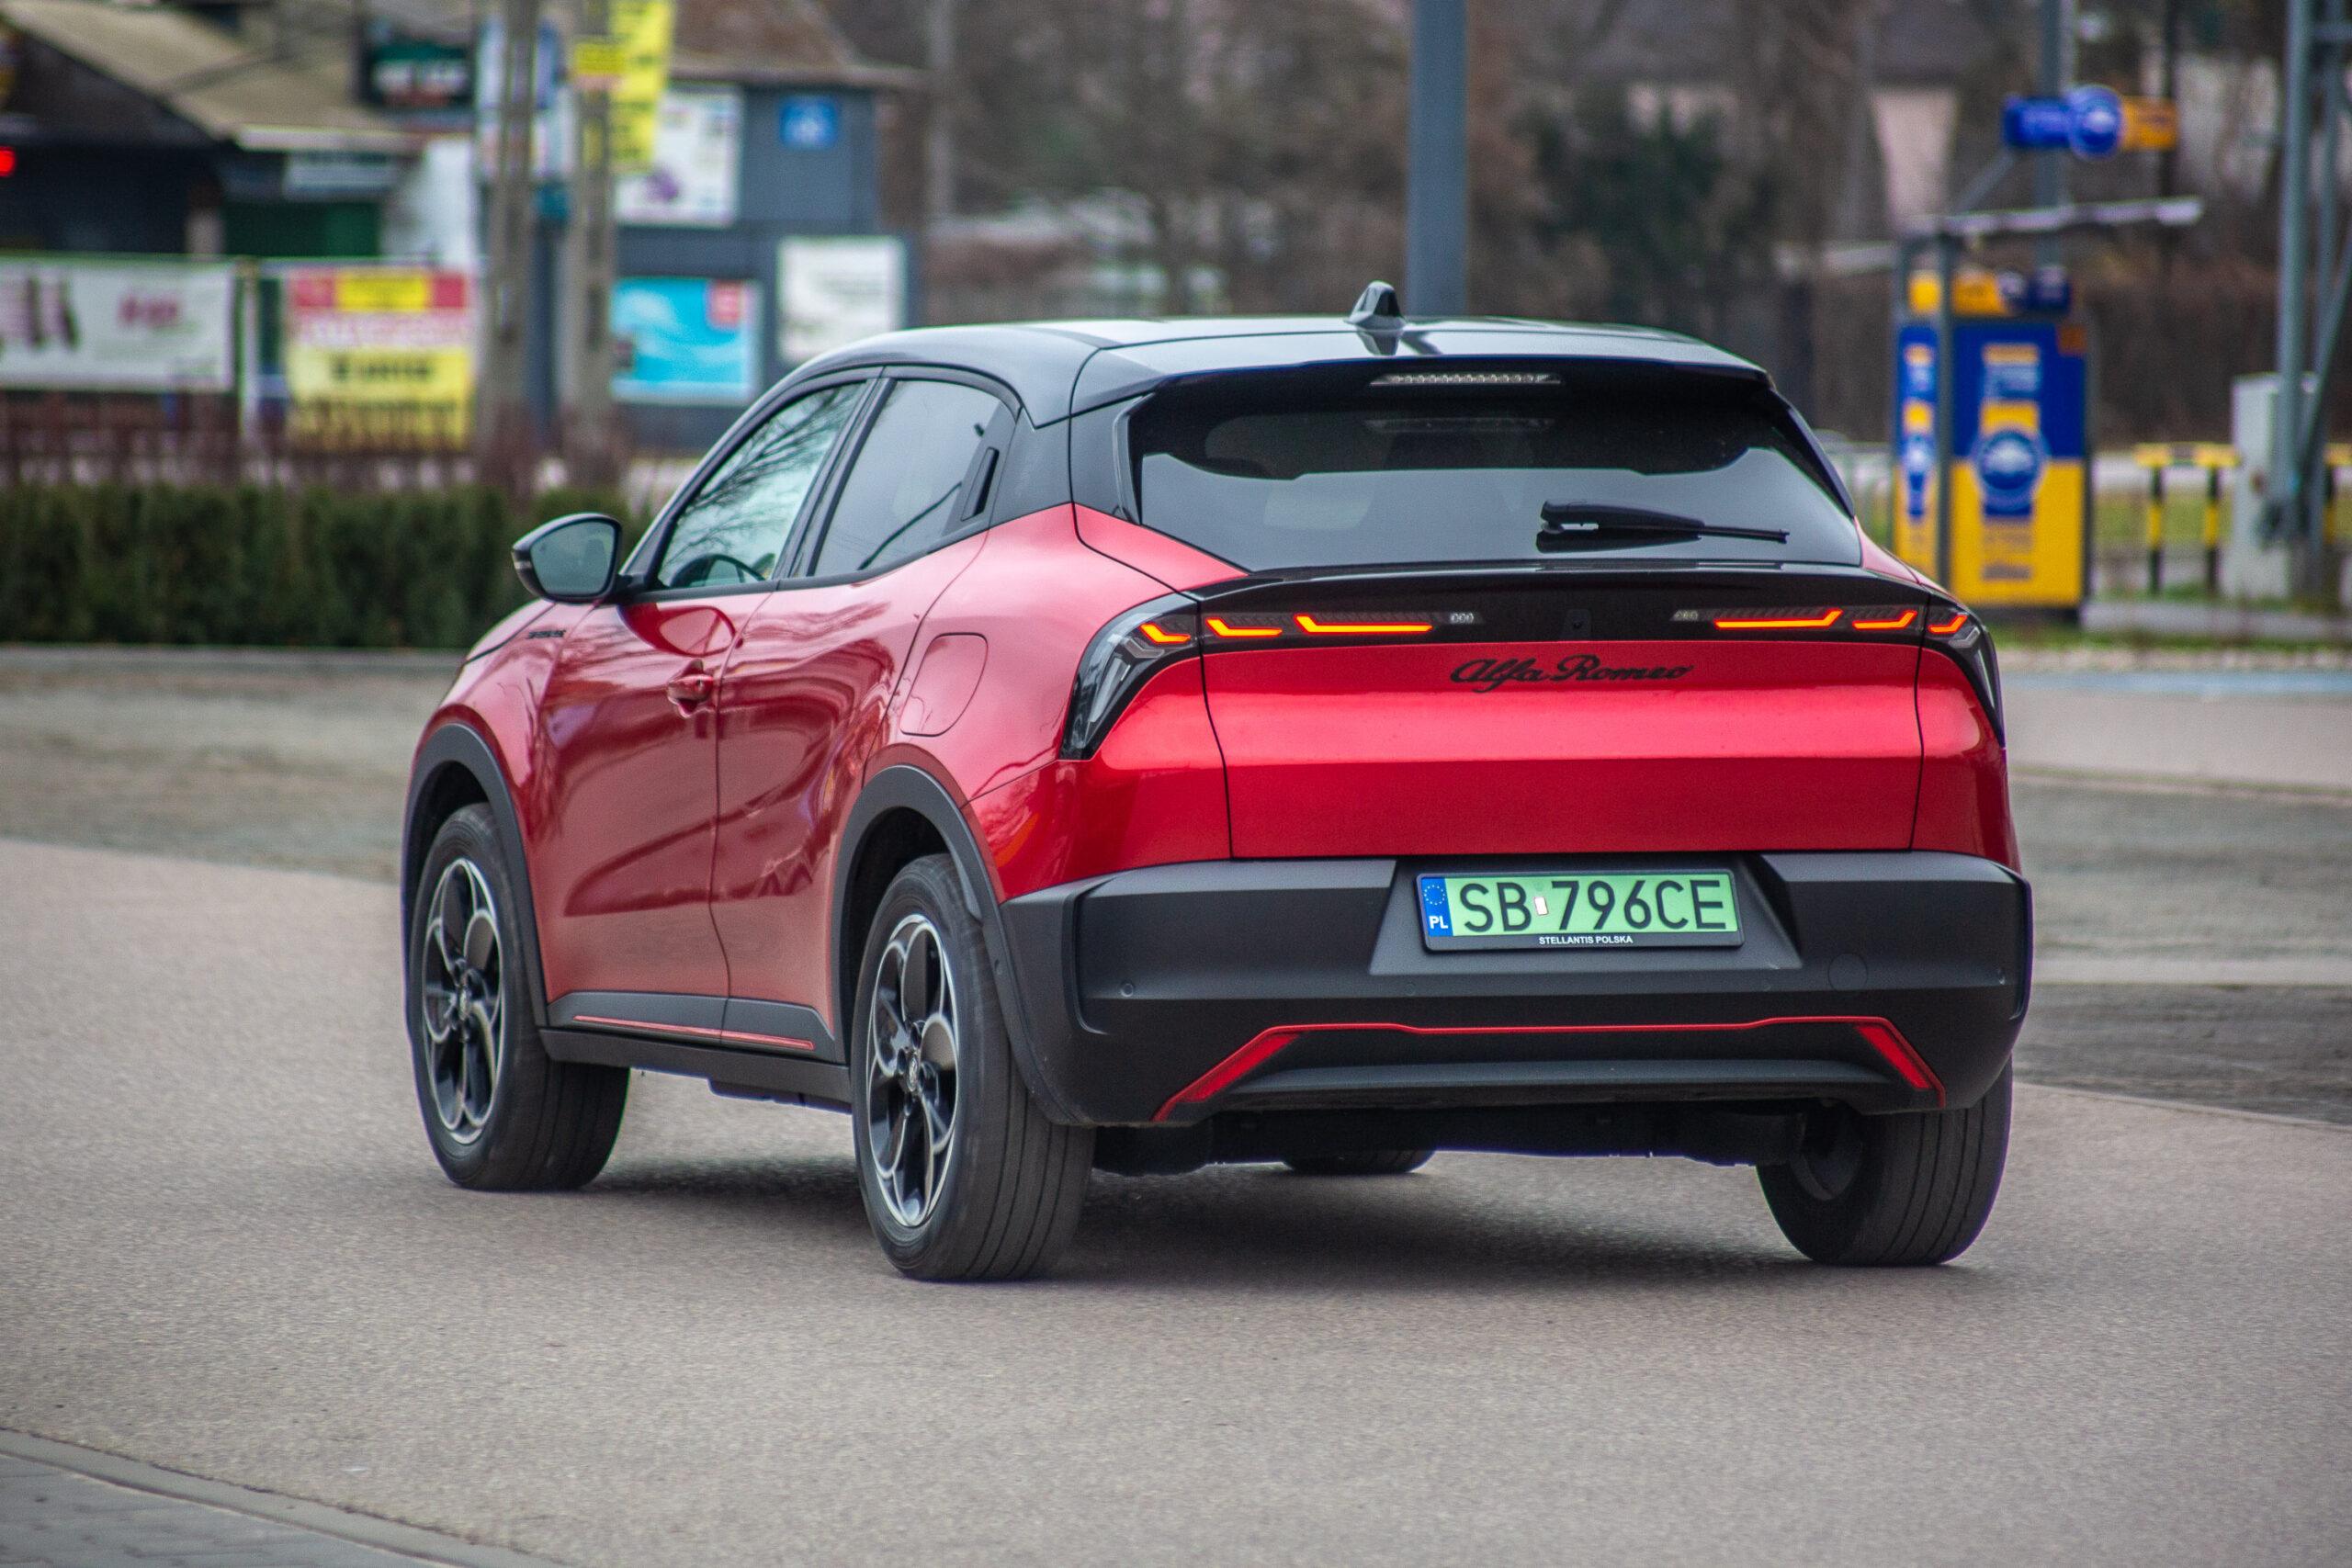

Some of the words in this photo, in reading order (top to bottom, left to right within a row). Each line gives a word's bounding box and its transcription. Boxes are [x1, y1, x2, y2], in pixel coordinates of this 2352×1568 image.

[1450, 658, 1550, 694] Alfa
[1555, 653, 1695, 682] Romeo
[1460, 882, 1532, 932] SB
[1551, 879, 1727, 931] 796CE
[1430, 916, 1449, 930] PL
[1539, 936, 1594, 945] STELLANTIS
[1596, 935, 1634, 944] POLSKA
